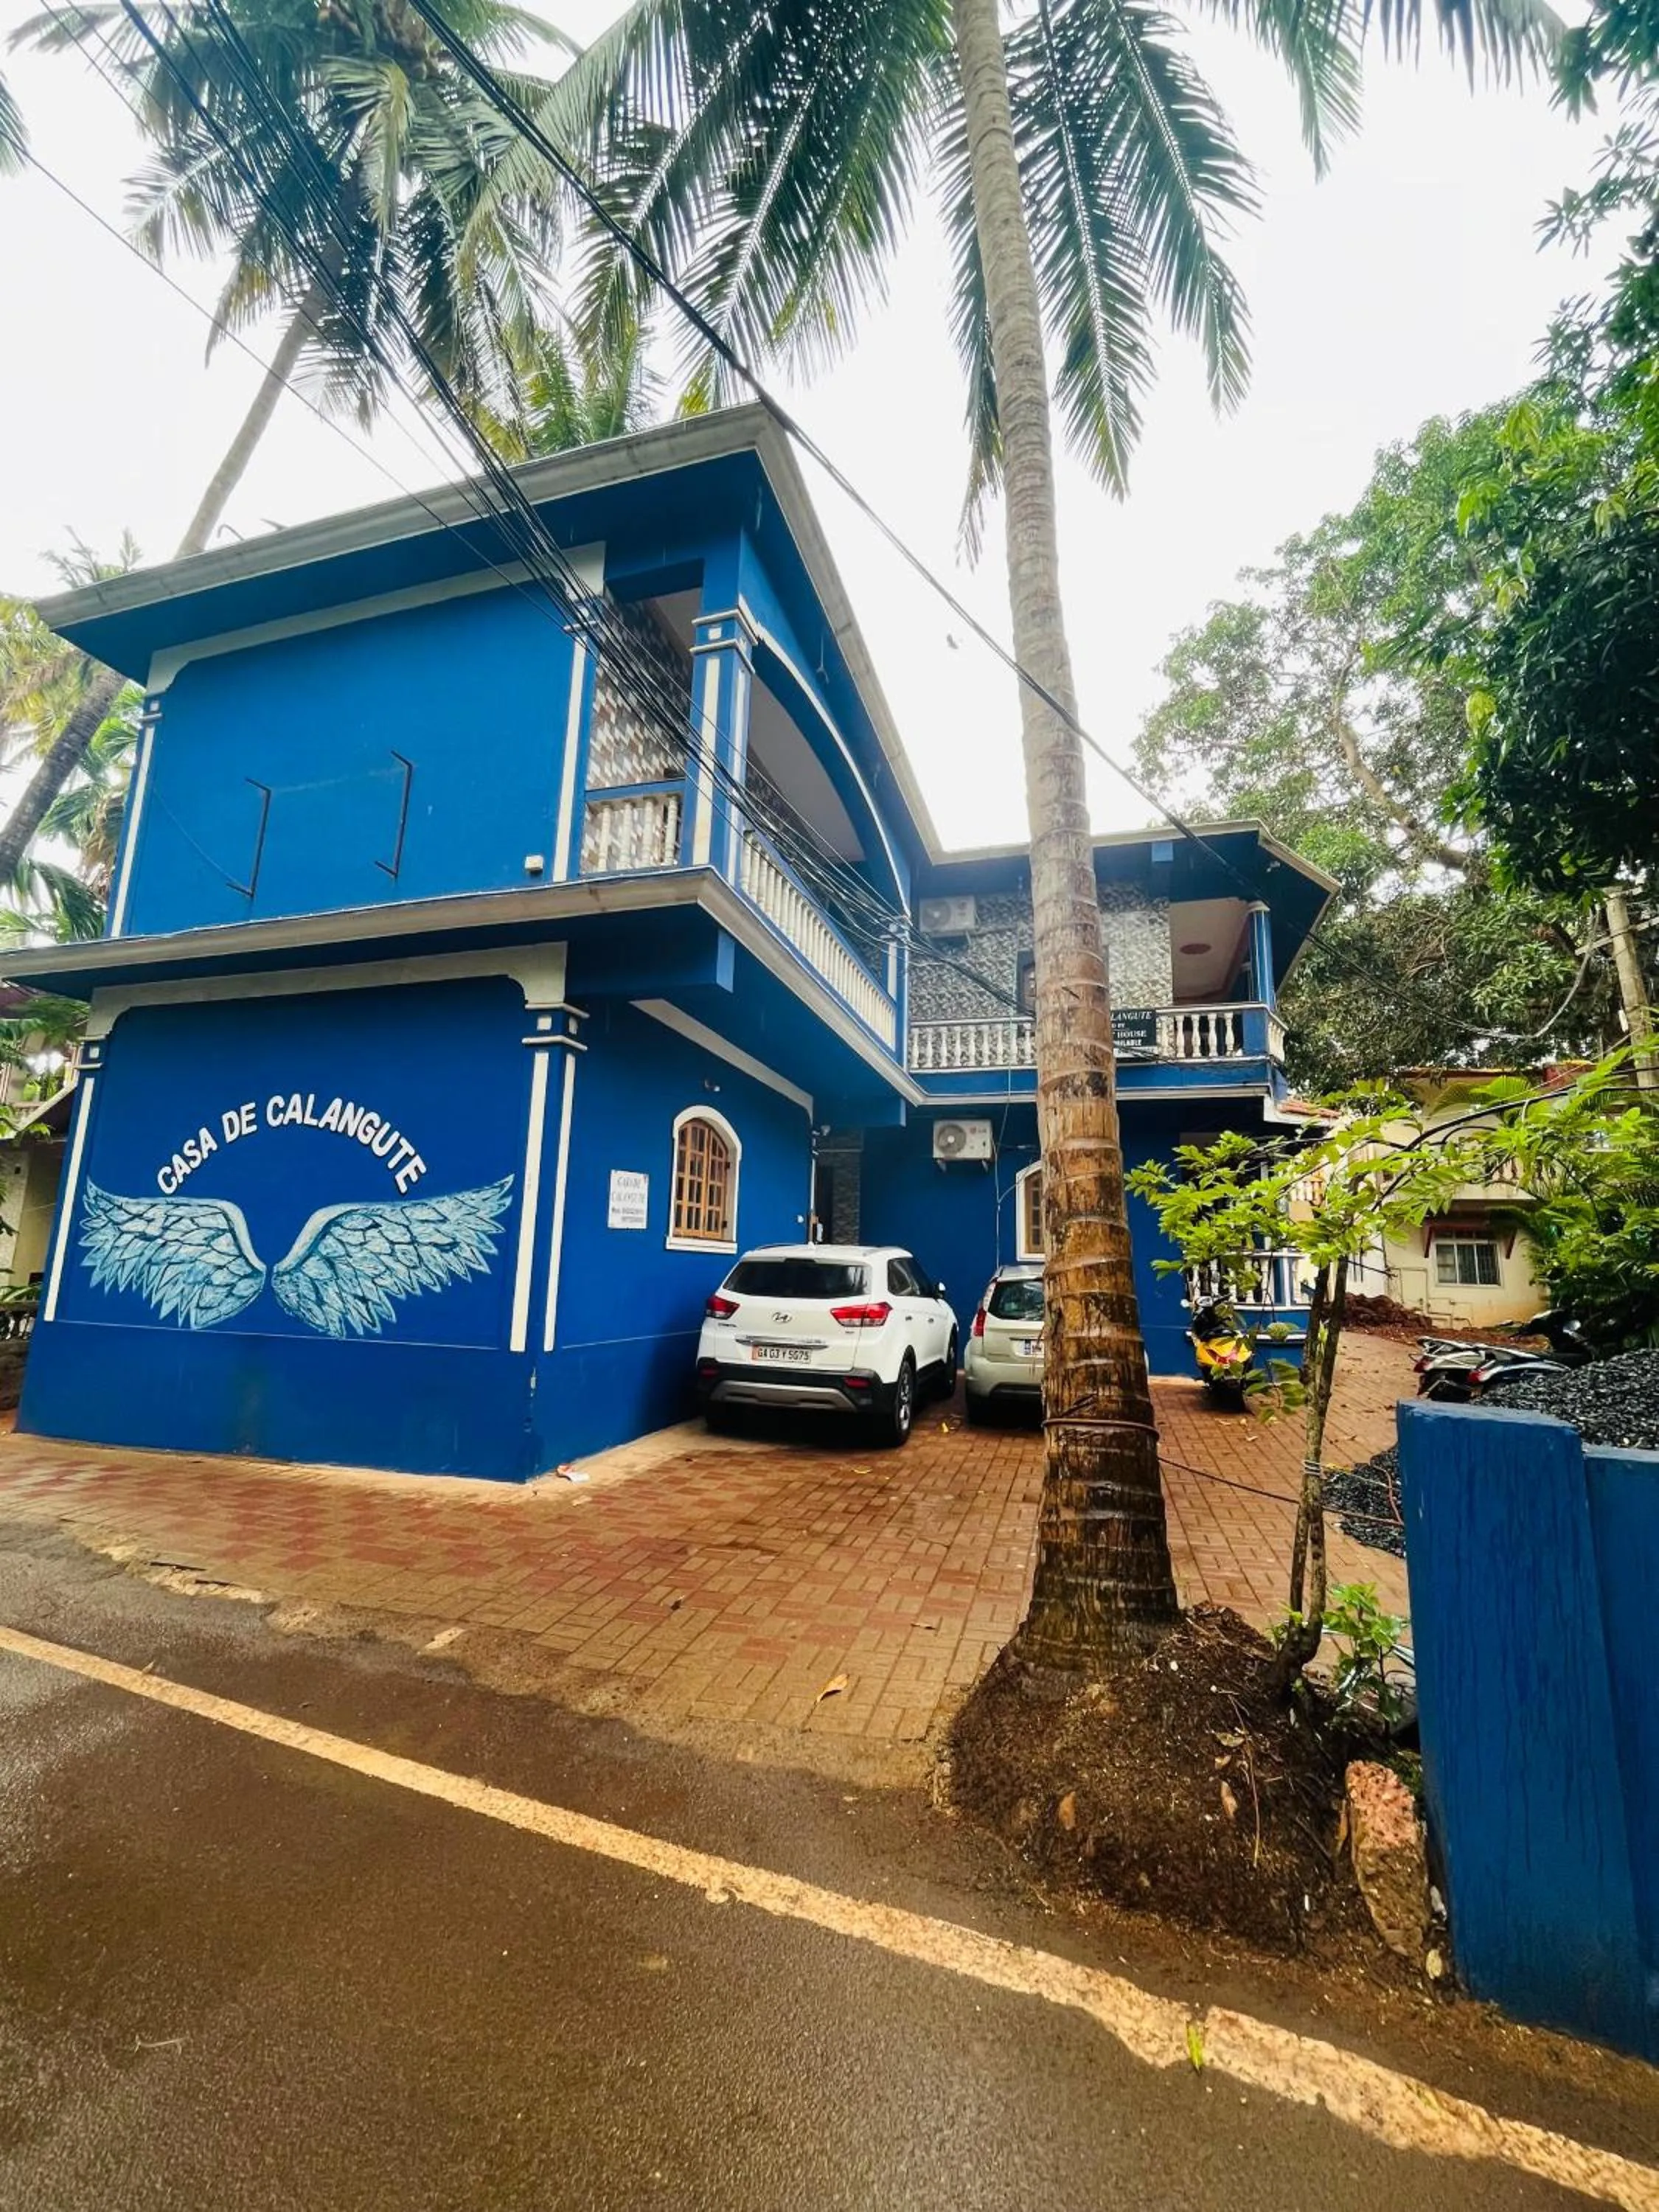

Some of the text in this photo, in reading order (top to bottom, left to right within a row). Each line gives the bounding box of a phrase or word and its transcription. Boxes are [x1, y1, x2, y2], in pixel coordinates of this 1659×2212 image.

[1110, 1012, 1152, 1020] LANGUTE
[1117, 1030, 1147, 1038] HOUSE
[157, 1093, 427, 1194] CASA DE CALANGUTE
